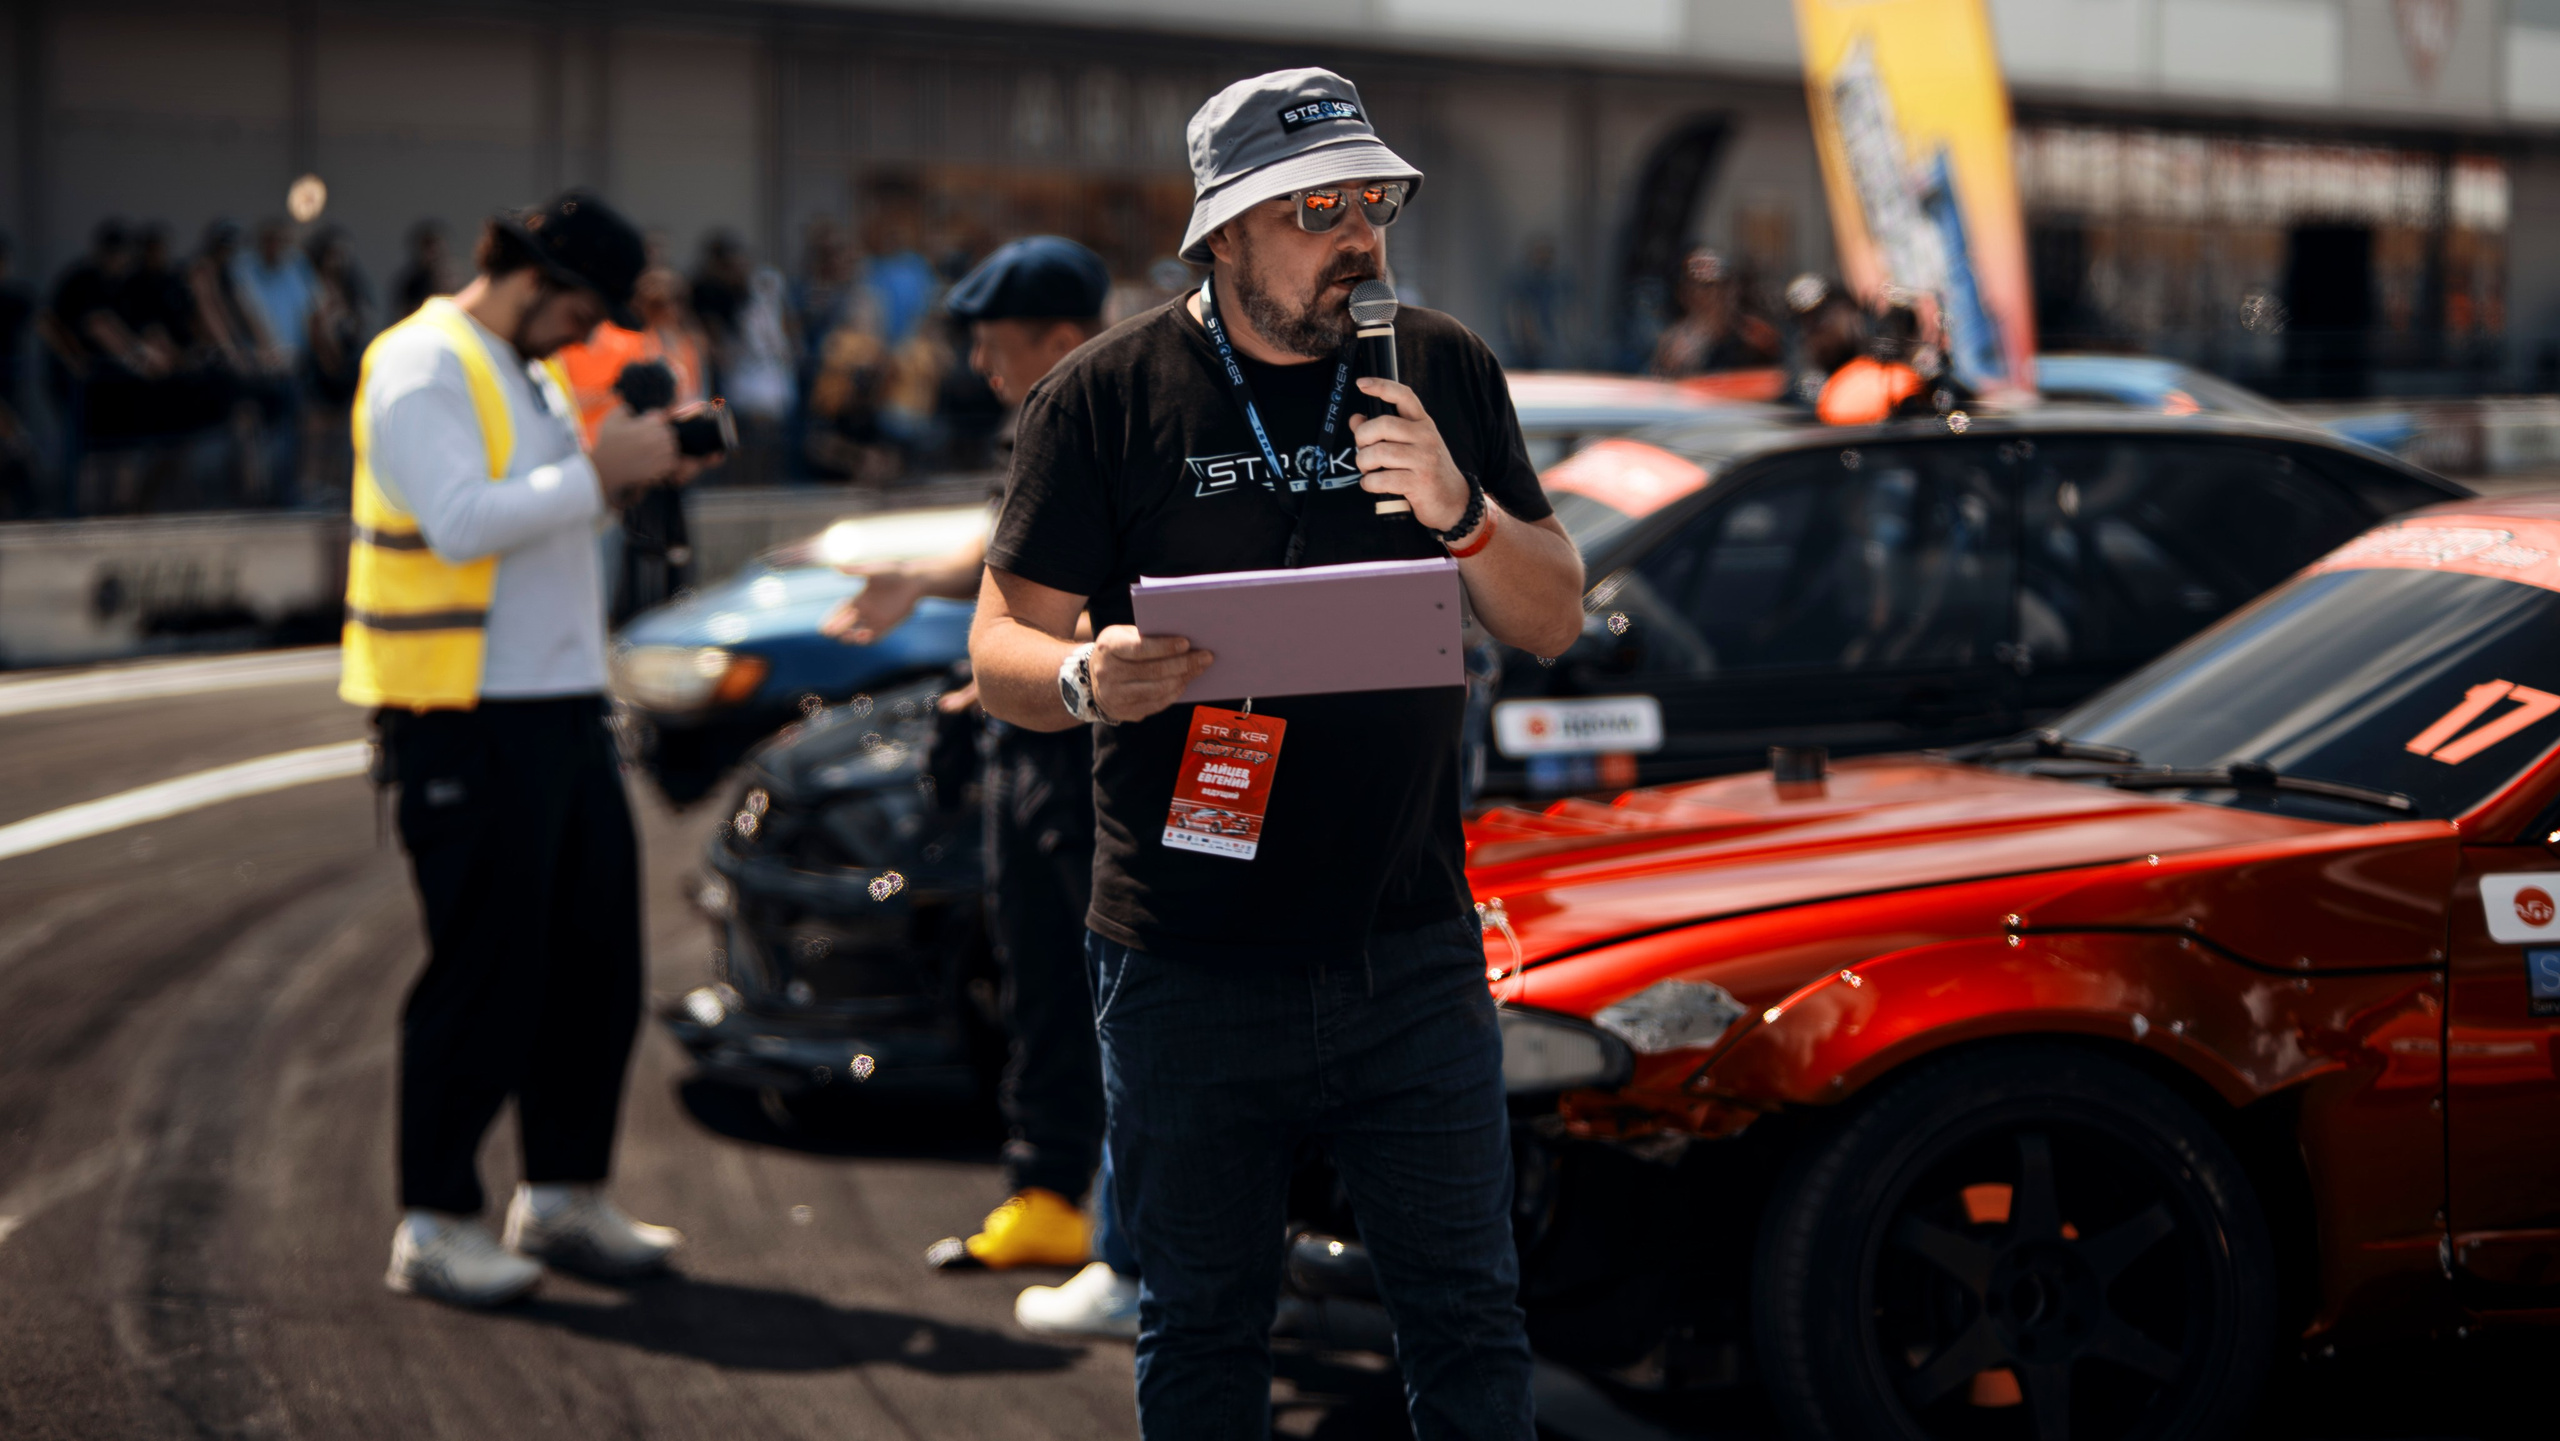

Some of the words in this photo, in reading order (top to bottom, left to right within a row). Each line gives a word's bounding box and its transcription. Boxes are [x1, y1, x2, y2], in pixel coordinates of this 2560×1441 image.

[1284, 101, 1359, 123] STROKER
[1207, 317, 1244, 386] STROKER
[1324, 363, 1348, 434] STROKER
[1201, 724, 1269, 743] STROKER
[2405, 678, 2560, 766] 17
[1202, 762, 1251, 780] ЗАЙЦЕВ
